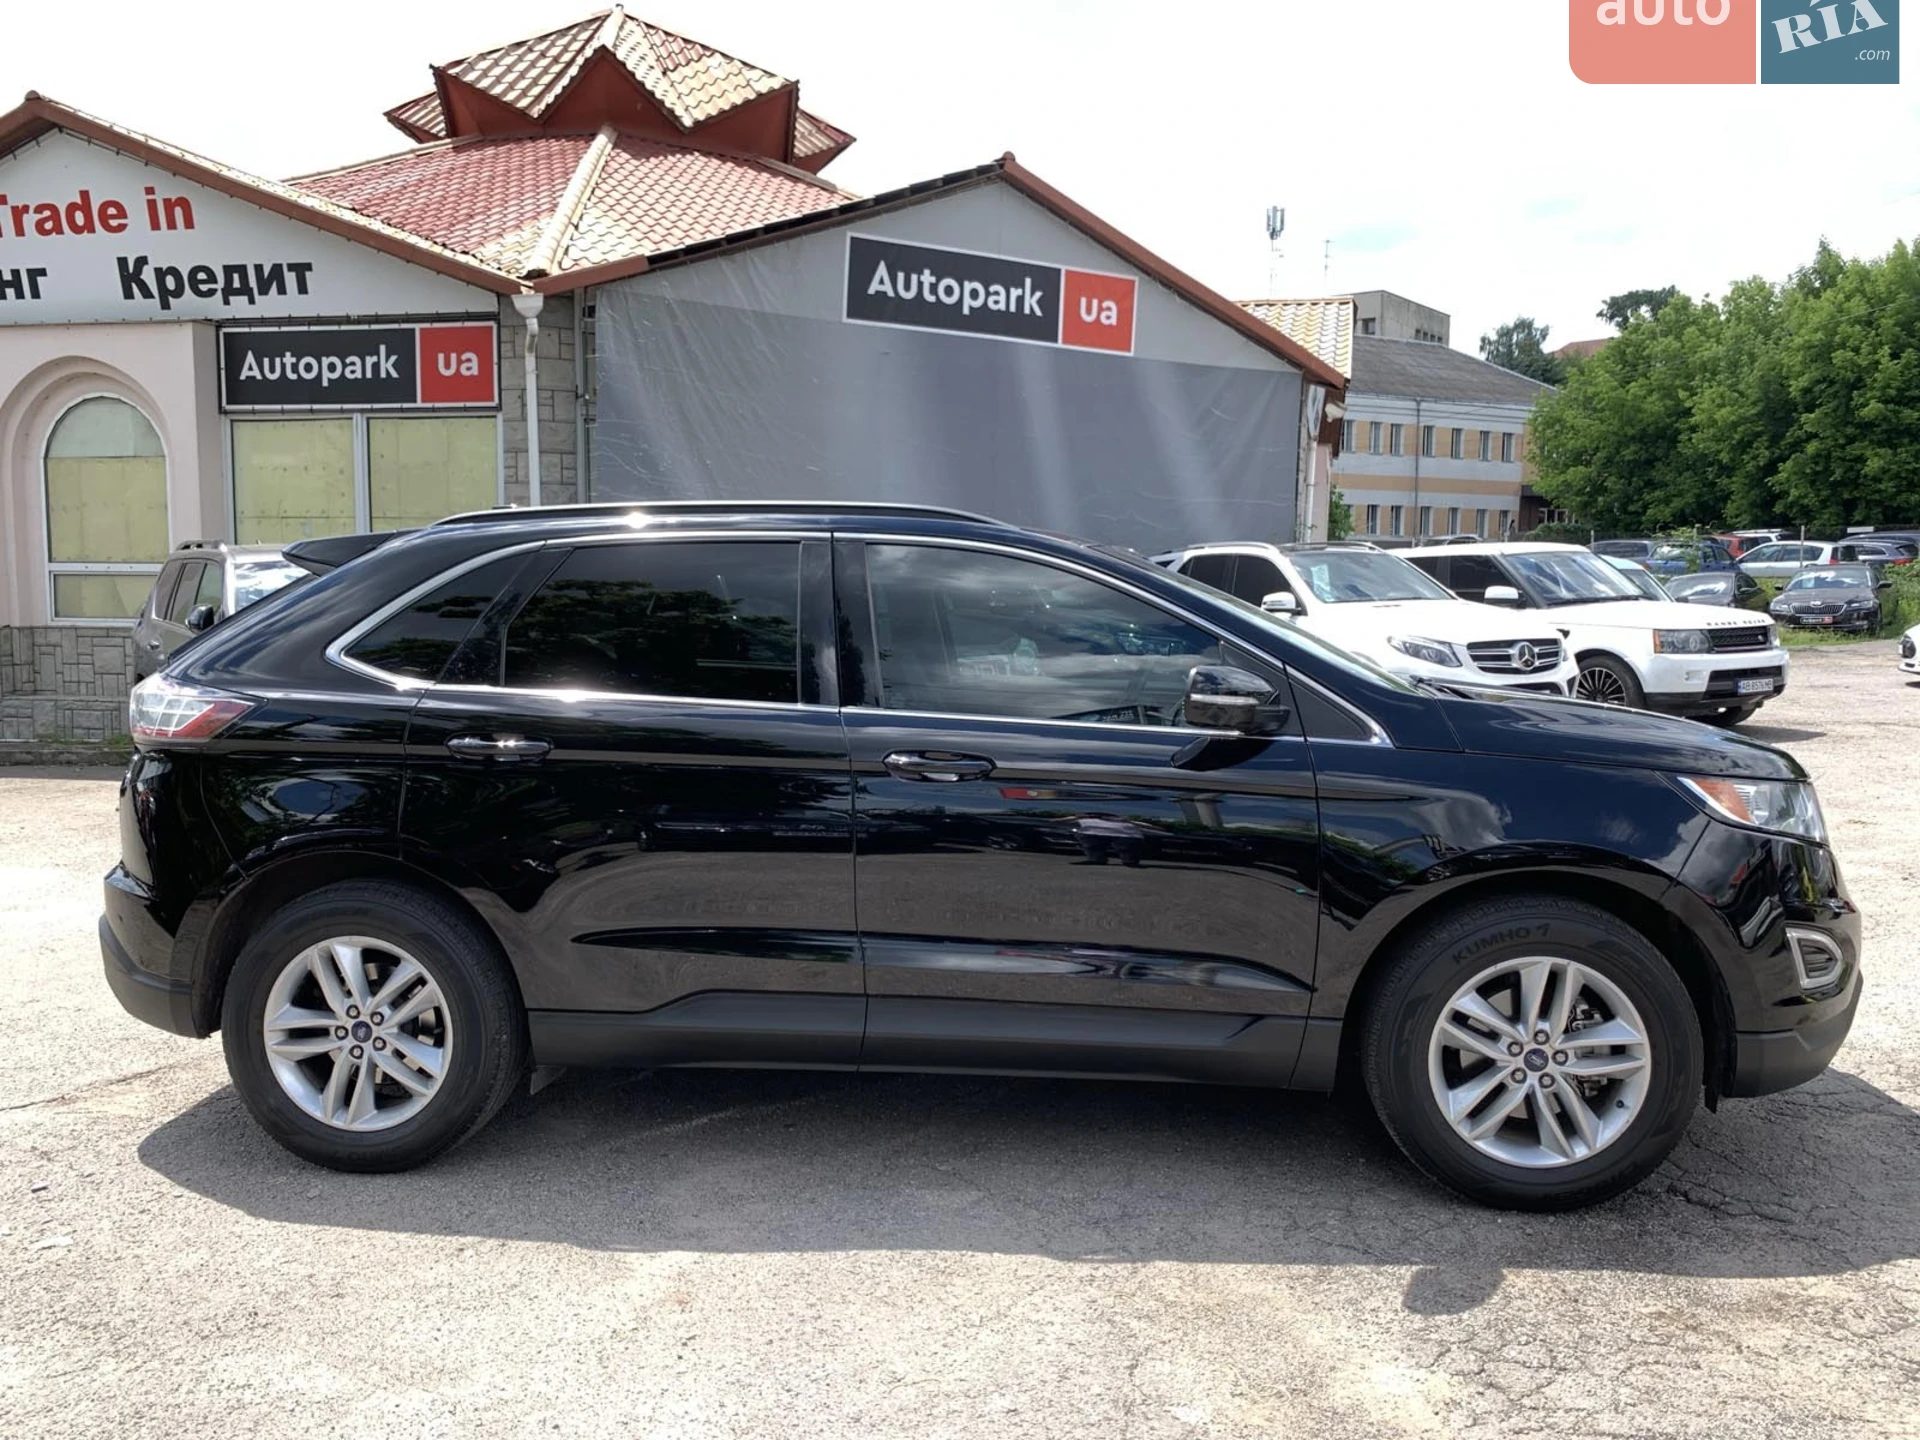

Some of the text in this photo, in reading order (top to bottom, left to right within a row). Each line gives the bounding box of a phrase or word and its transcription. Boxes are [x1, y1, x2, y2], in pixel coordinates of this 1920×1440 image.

[144, 186, 195, 232] in
[116, 255, 313, 310] Кредит
[867, 260, 1118, 326] Autopark ua
[239, 344, 479, 387] Autopark ua
[1452, 927, 1531, 965] KUMHO
